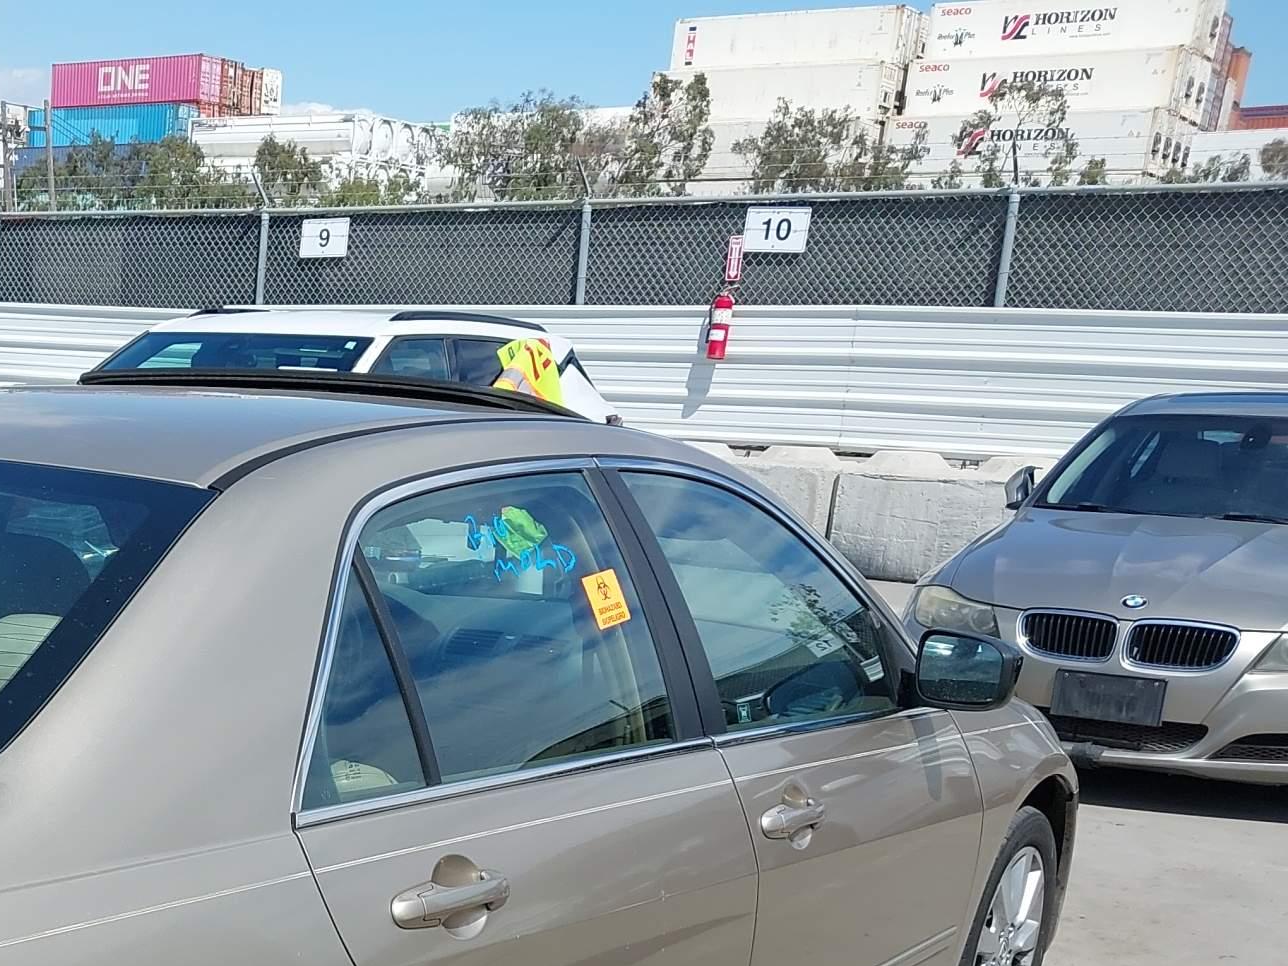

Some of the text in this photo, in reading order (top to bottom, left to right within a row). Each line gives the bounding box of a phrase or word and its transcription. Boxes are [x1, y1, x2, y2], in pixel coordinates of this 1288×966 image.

[941, 7, 972, 17] seaco
[1034, 8, 1118, 26] HORIZON
[1031, 22, 1102, 36] LINES
[919, 63, 950, 73] seaco
[1011, 67, 1094, 83] HORIZON
[98, 64, 150, 92] ONE
[990, 127, 1071, 142] HORIZON
[762, 217, 792, 241] 10
[319, 228, 331, 248] 9
[493, 543, 576, 583] MOLD
